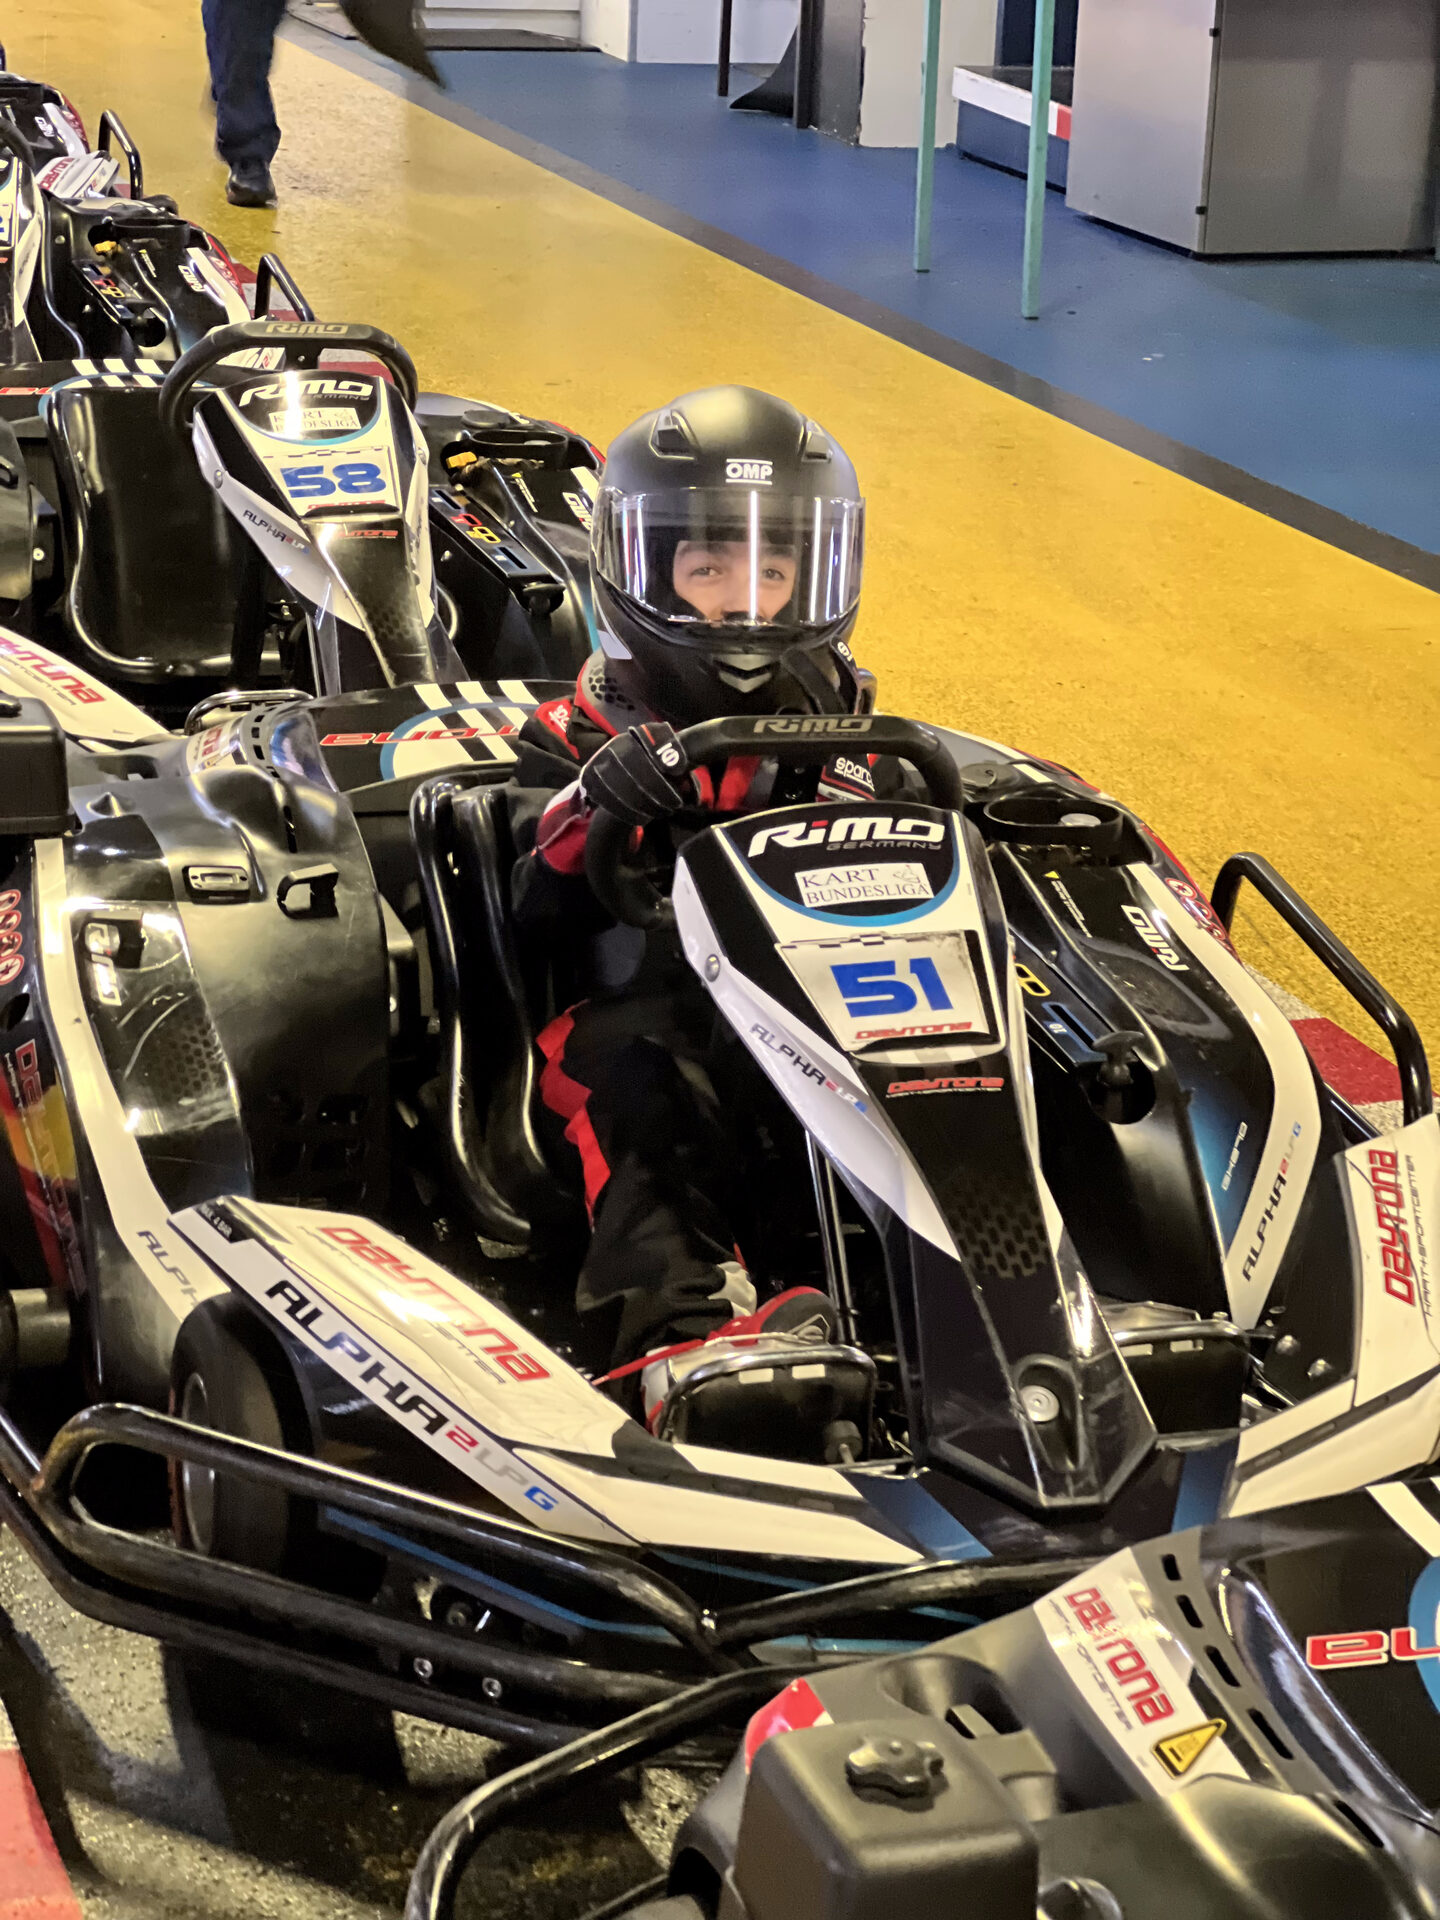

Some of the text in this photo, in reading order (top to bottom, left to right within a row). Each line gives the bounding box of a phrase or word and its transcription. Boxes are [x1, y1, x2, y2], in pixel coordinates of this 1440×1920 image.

[239, 380, 373, 407] RMO
[273, 411, 323, 424] KRT
[276, 419, 360, 433] BDESLIGA
[280, 463, 386, 498] 58
[726, 462, 773, 480] OMP
[826, 840, 942, 851] GERMANY
[802, 868, 880, 888] KART
[806, 883, 931, 905] BUNDESLIGA
[830, 957, 954, 1018] 51
